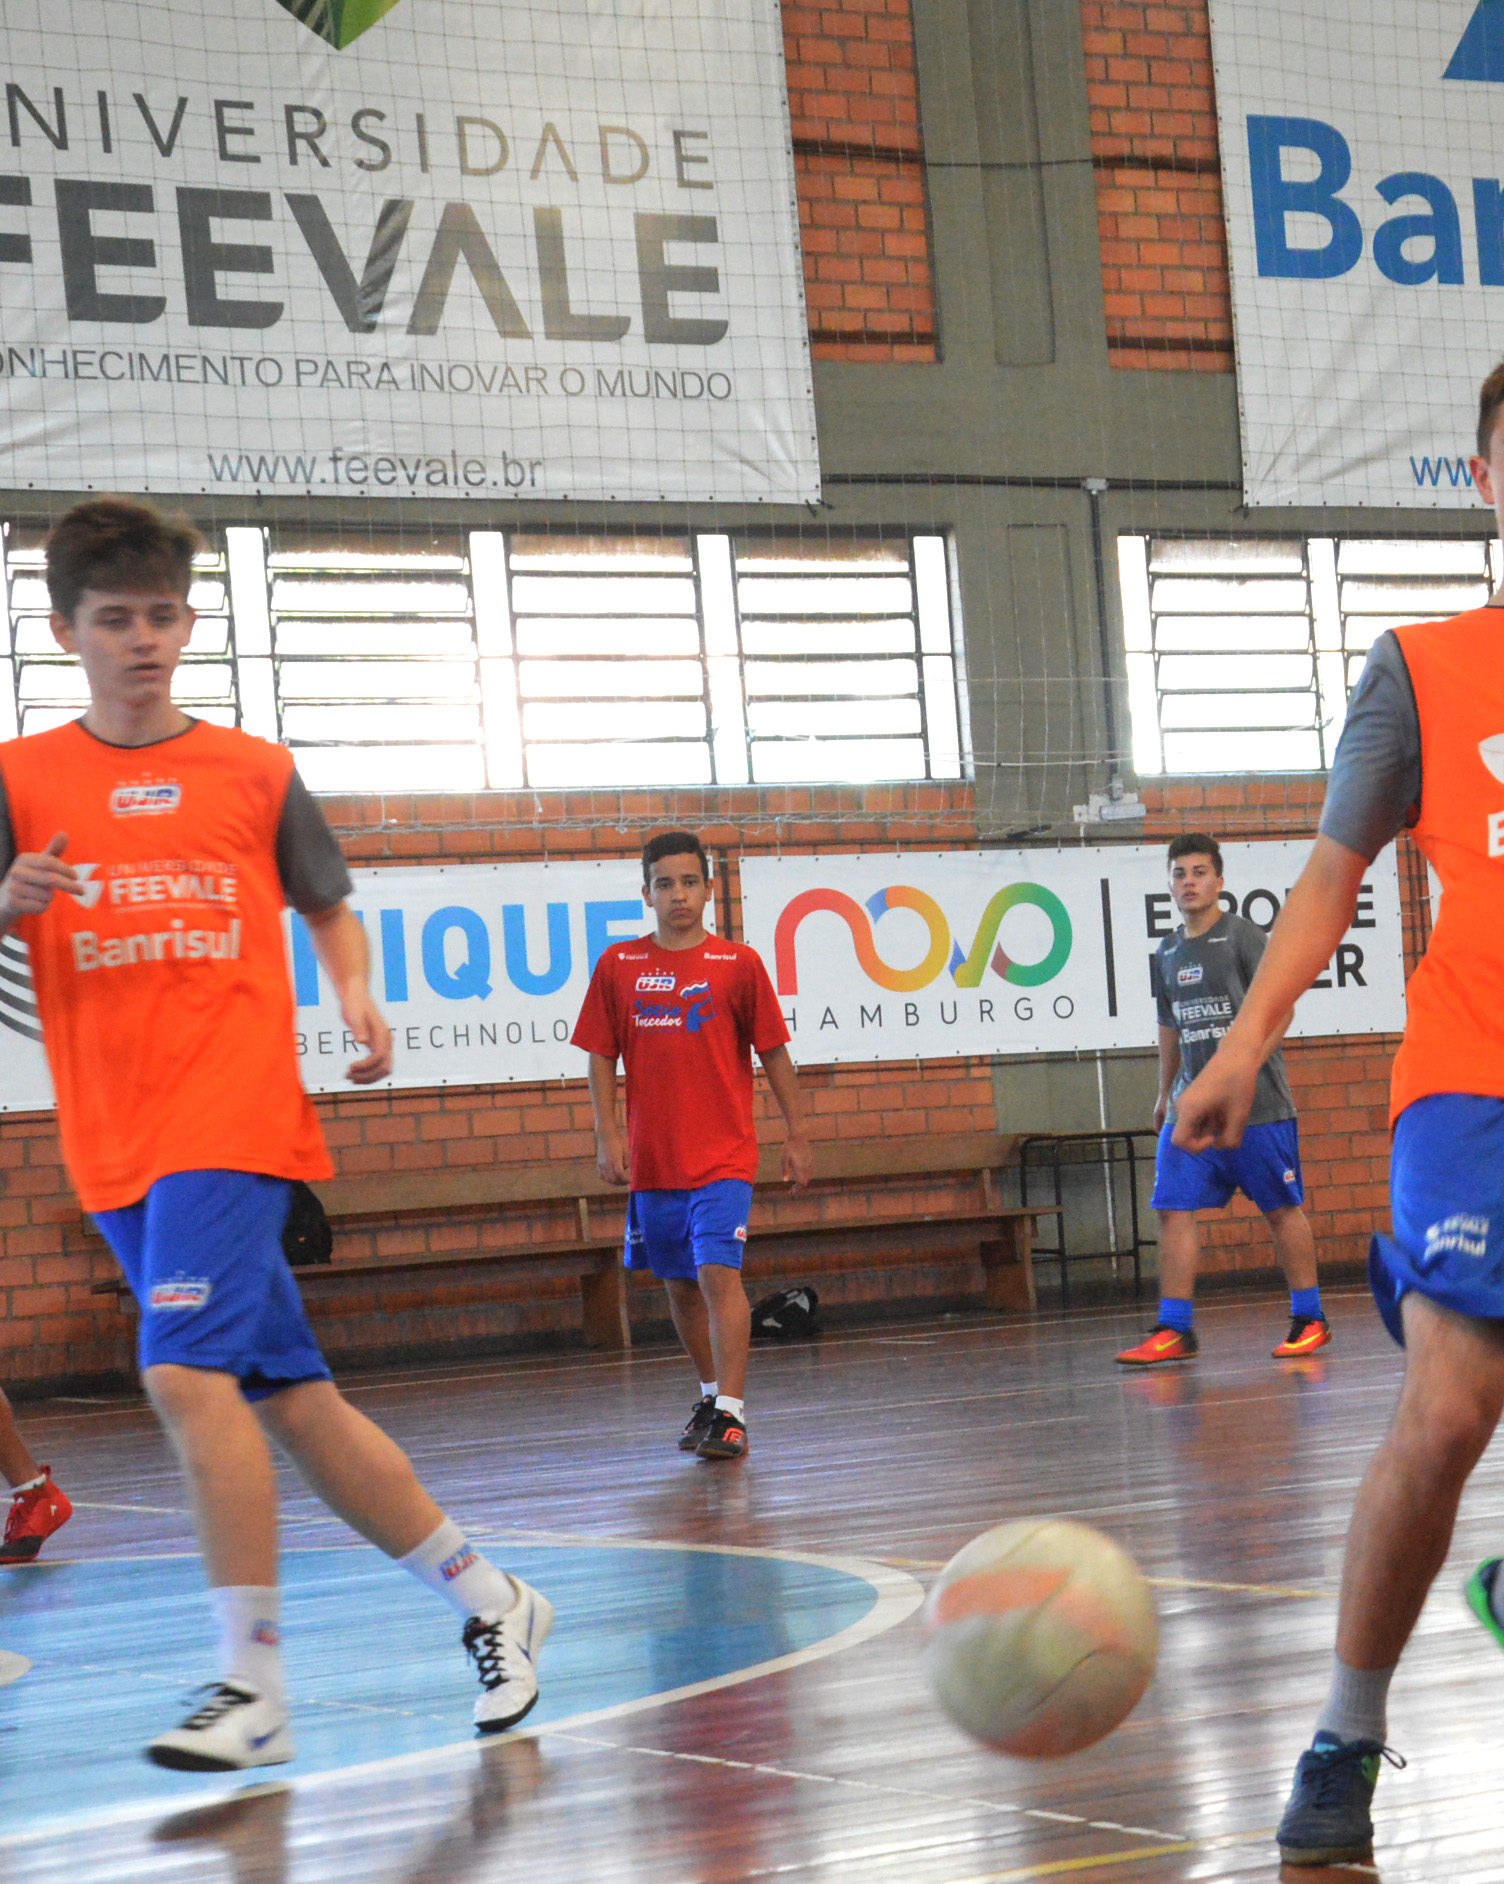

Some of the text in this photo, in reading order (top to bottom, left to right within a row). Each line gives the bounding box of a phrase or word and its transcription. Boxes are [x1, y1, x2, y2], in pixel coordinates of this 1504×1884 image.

[0, 346, 732, 400] NHECIMENTO PARA INOVAR O MUNDO
[208, 446, 542, 488] www.feevale.br
[108, 874, 238, 905] FEEVALE
[72, 917, 242, 972] Banrisul
[703, 951, 738, 961] Banrisul
[783, 995, 1075, 1032] HAMBURGO
[1181, 1001, 1232, 1020] FEEVALE
